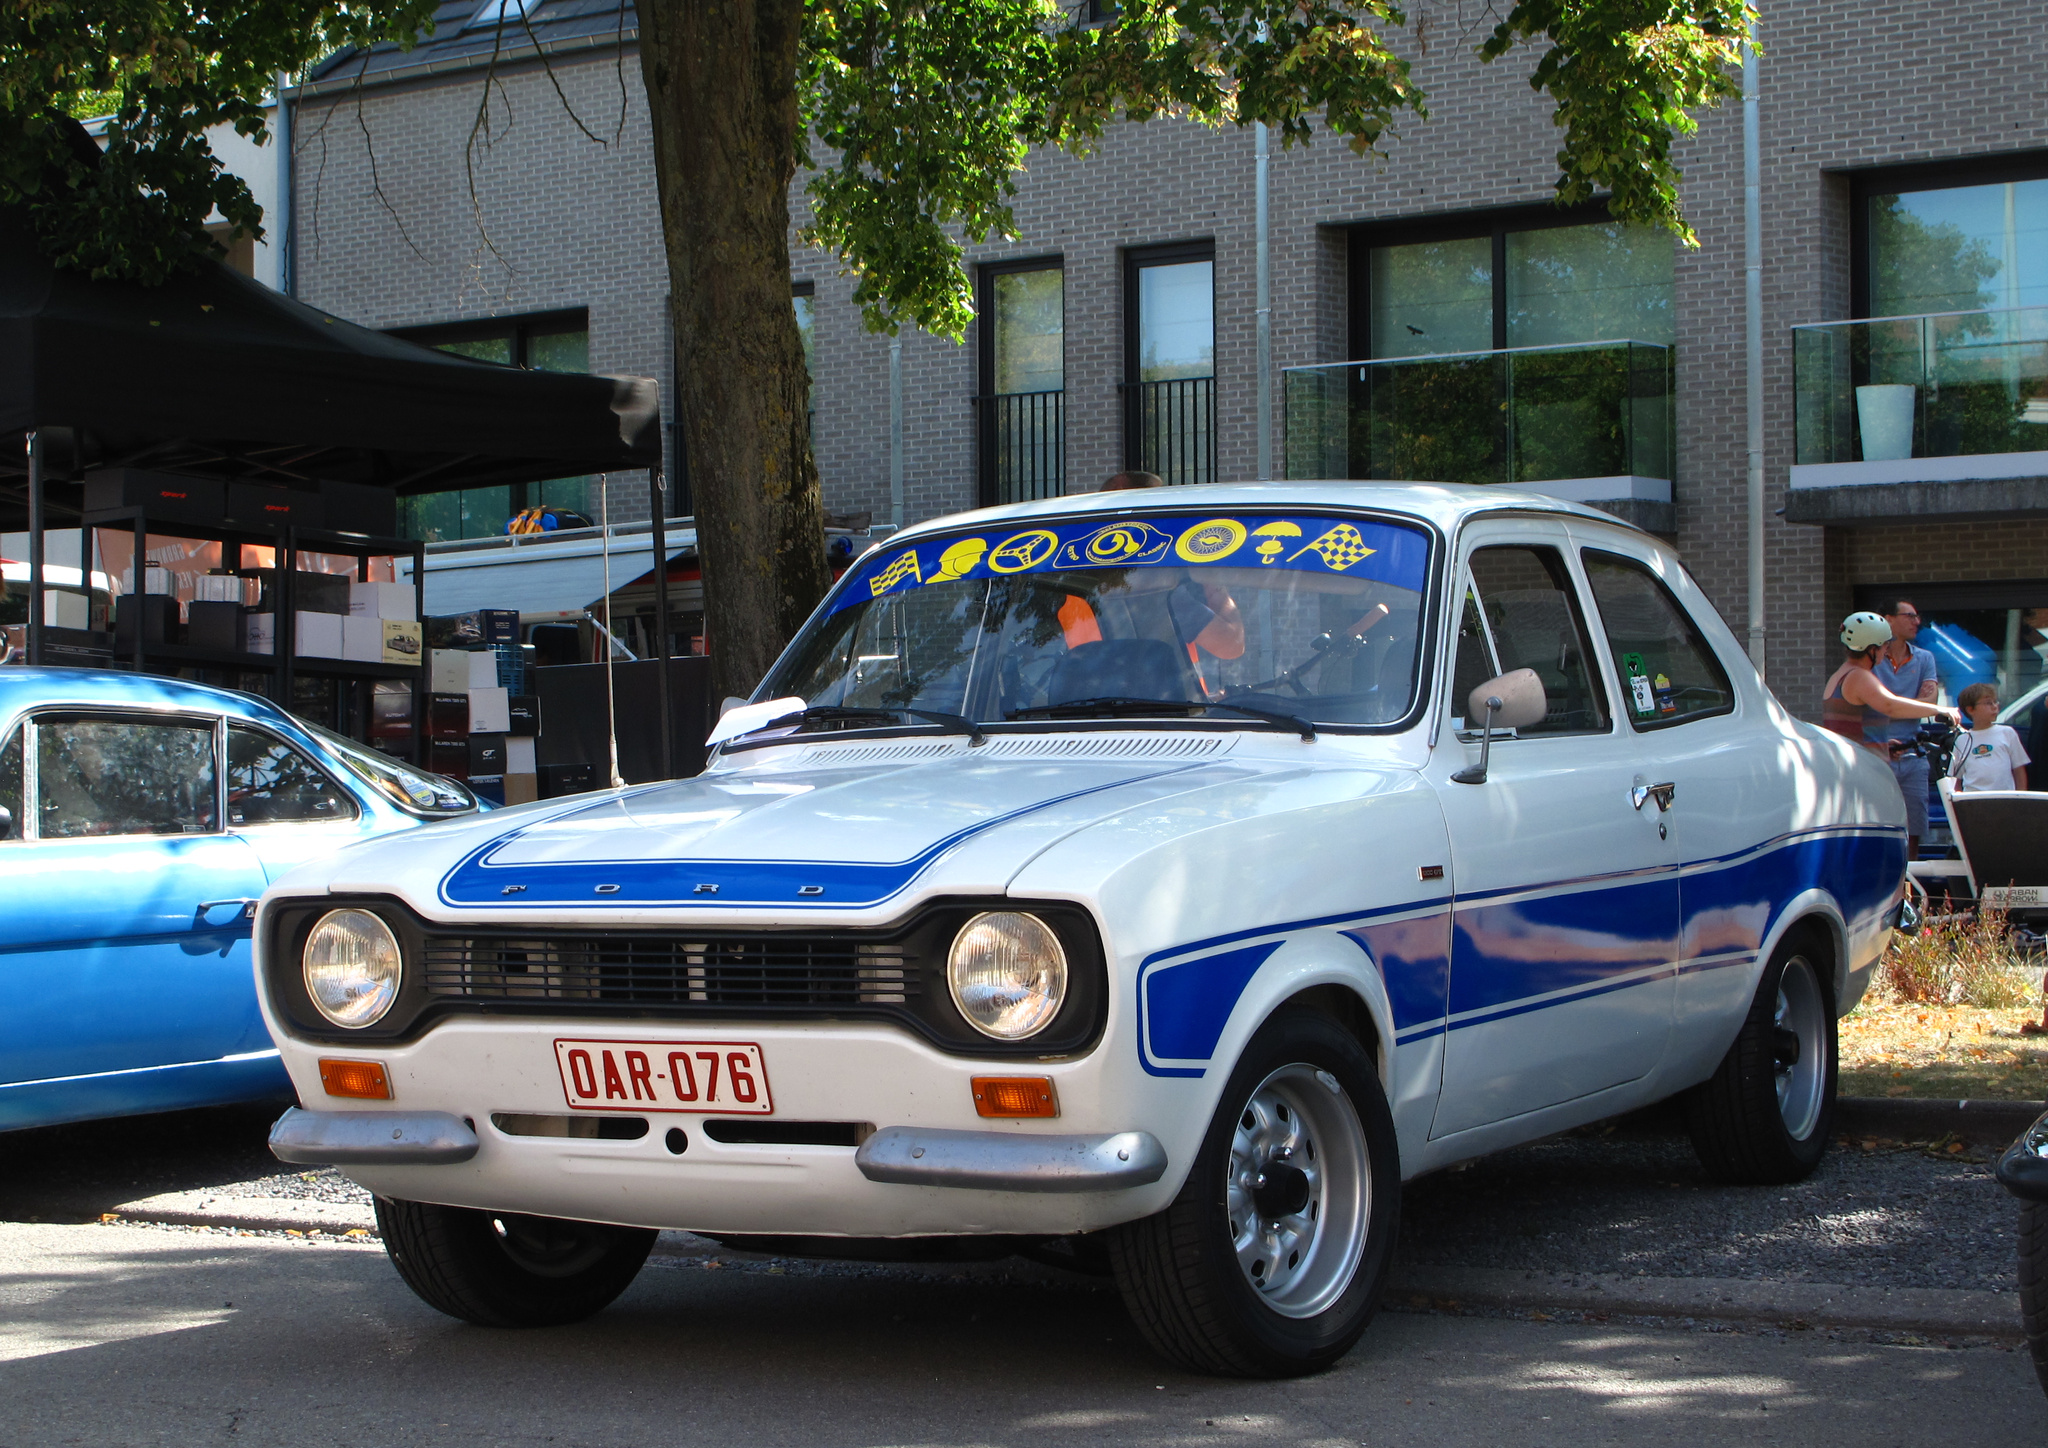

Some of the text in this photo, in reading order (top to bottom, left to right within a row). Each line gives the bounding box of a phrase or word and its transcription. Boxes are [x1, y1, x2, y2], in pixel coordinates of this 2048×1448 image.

[1137, 541, 1167, 557] CLASSIC
[502, 883, 825, 896] FORD
[568, 1049, 758, 1103] OAR-076
